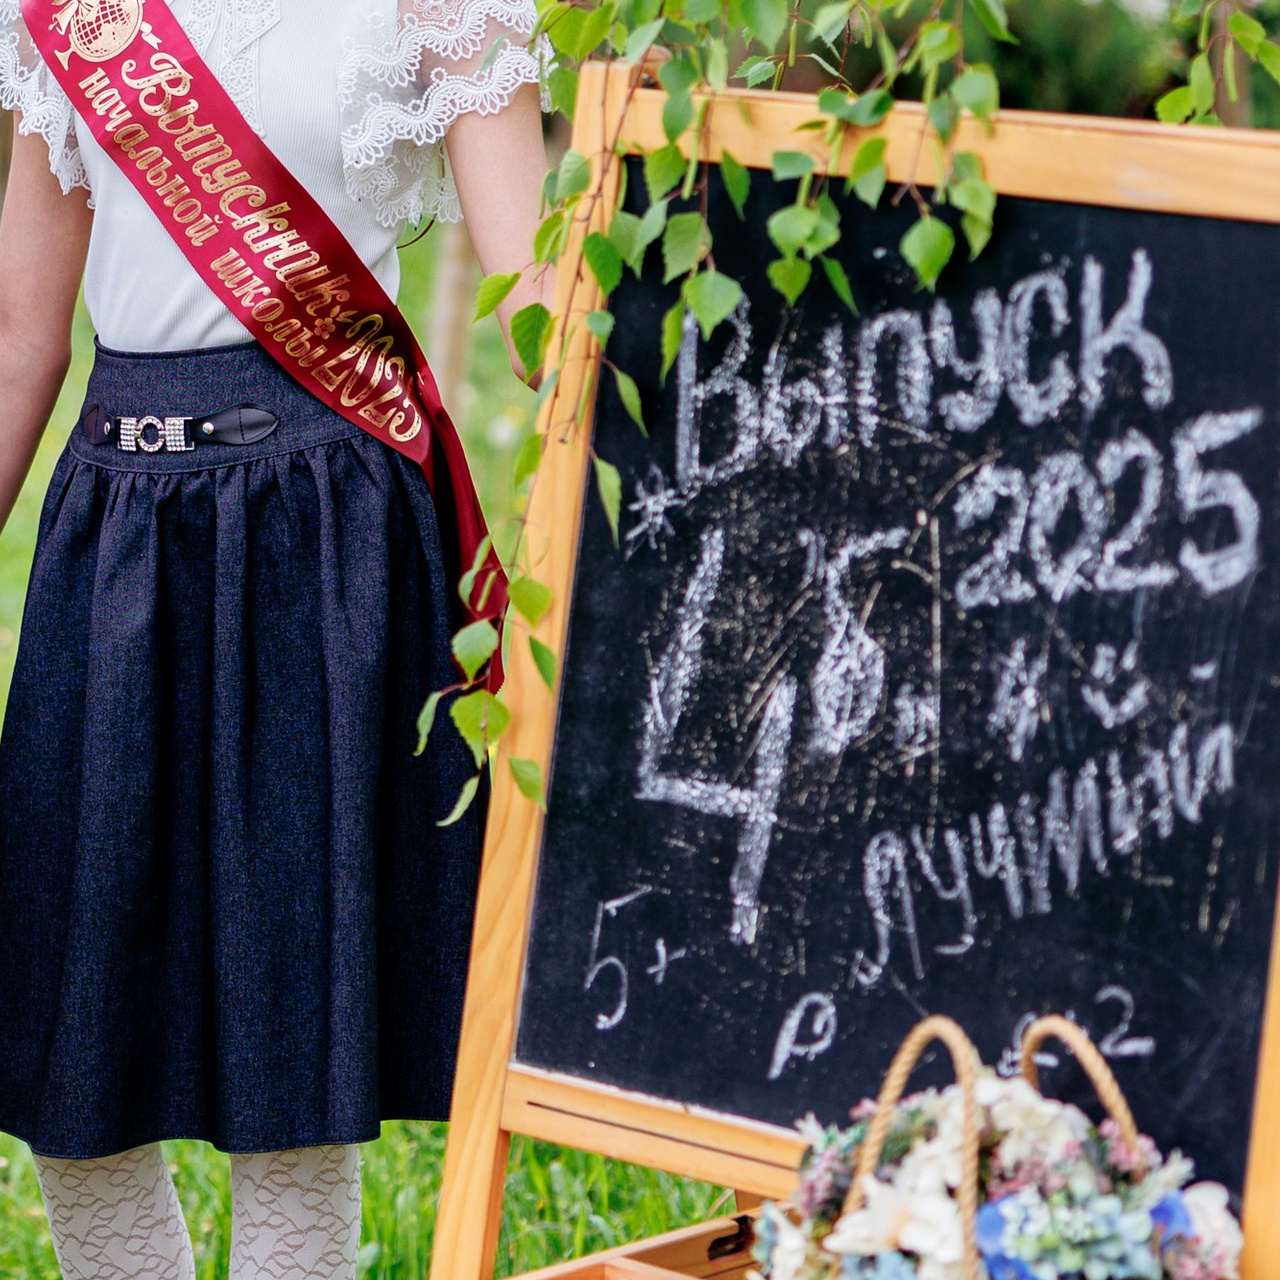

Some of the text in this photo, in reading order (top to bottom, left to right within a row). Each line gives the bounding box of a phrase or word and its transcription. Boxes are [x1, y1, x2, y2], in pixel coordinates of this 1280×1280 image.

[78, 67, 328, 368] начальной школы
[121, 52, 423, 442] Выпускник 2025
[953, 407, 1262, 608] 2025
